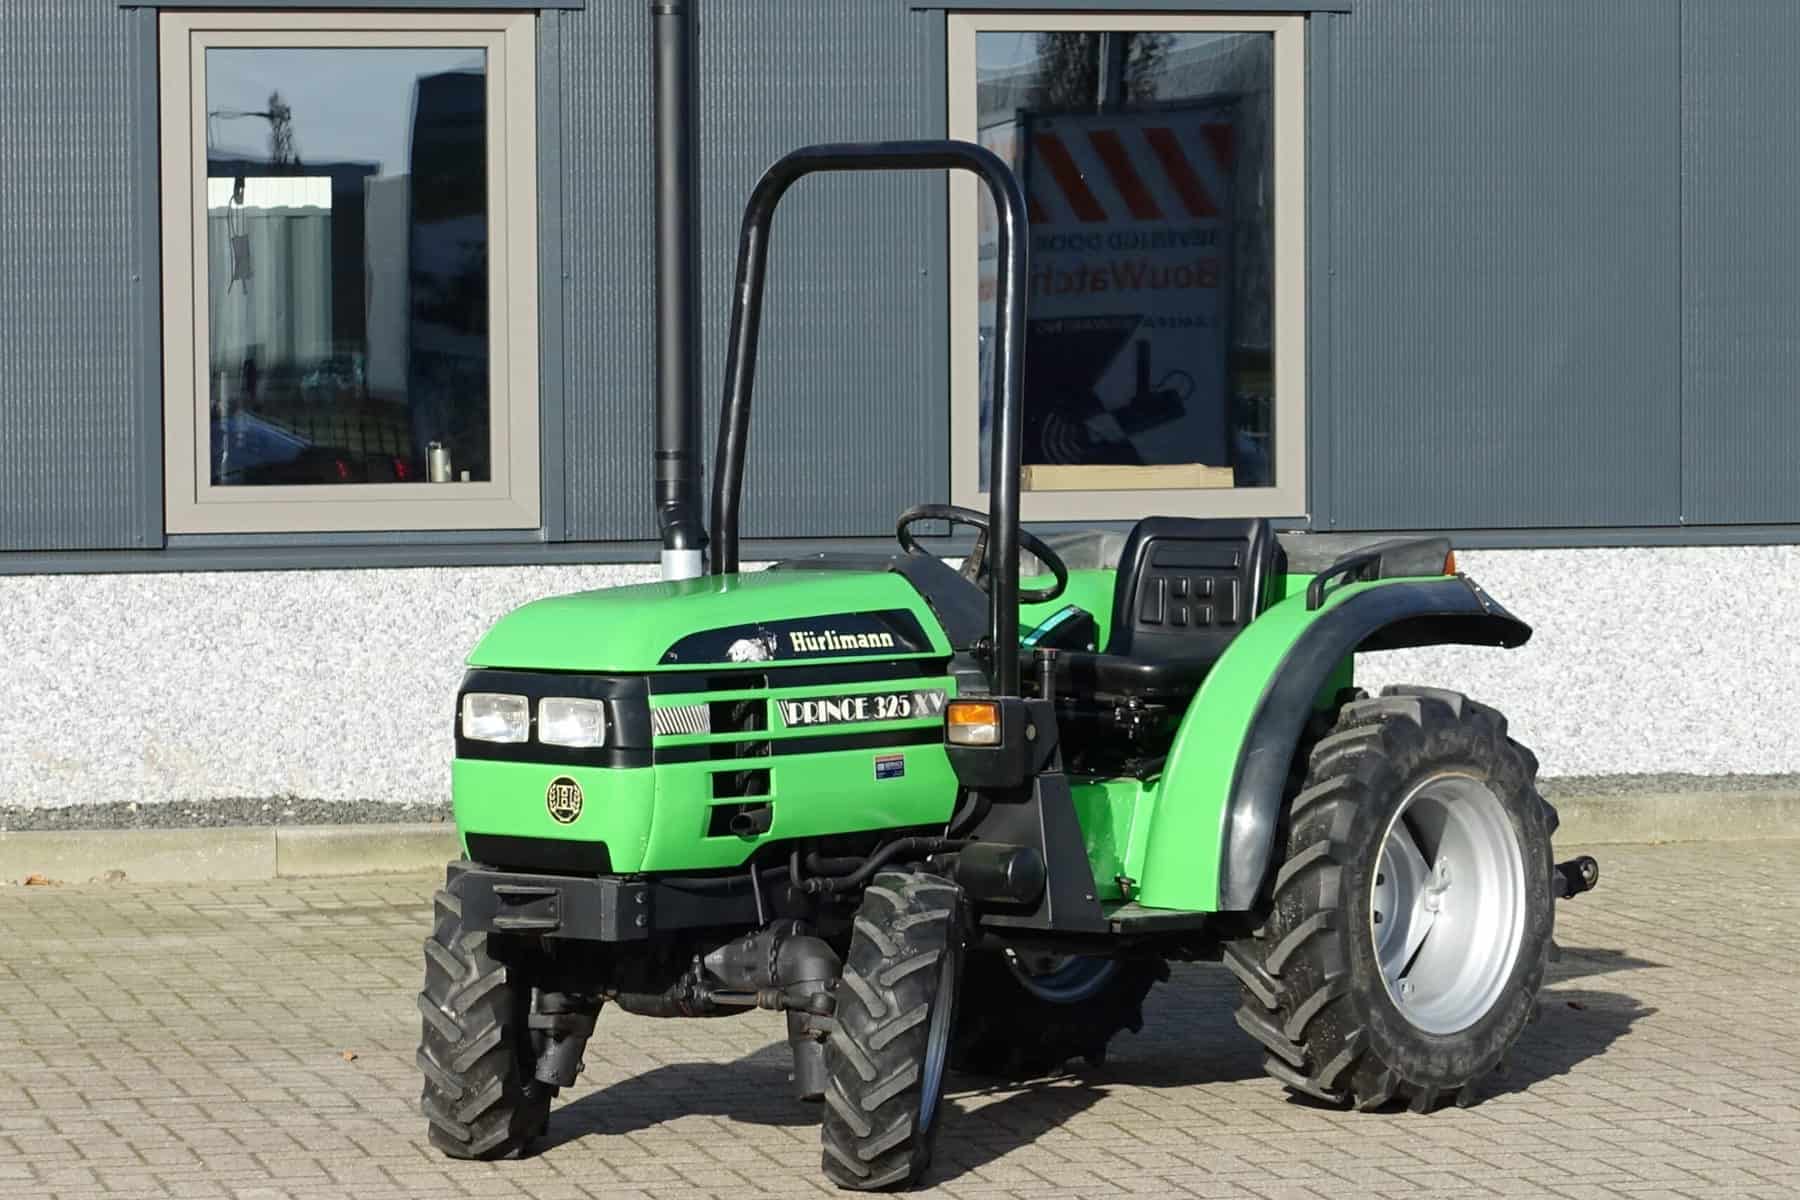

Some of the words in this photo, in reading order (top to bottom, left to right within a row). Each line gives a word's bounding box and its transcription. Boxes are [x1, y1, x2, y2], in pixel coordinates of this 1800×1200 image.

[789, 630, 894, 652] Hürlimann
[787, 697, 869, 725] PRINCE
[873, 694, 911, 720] 325
